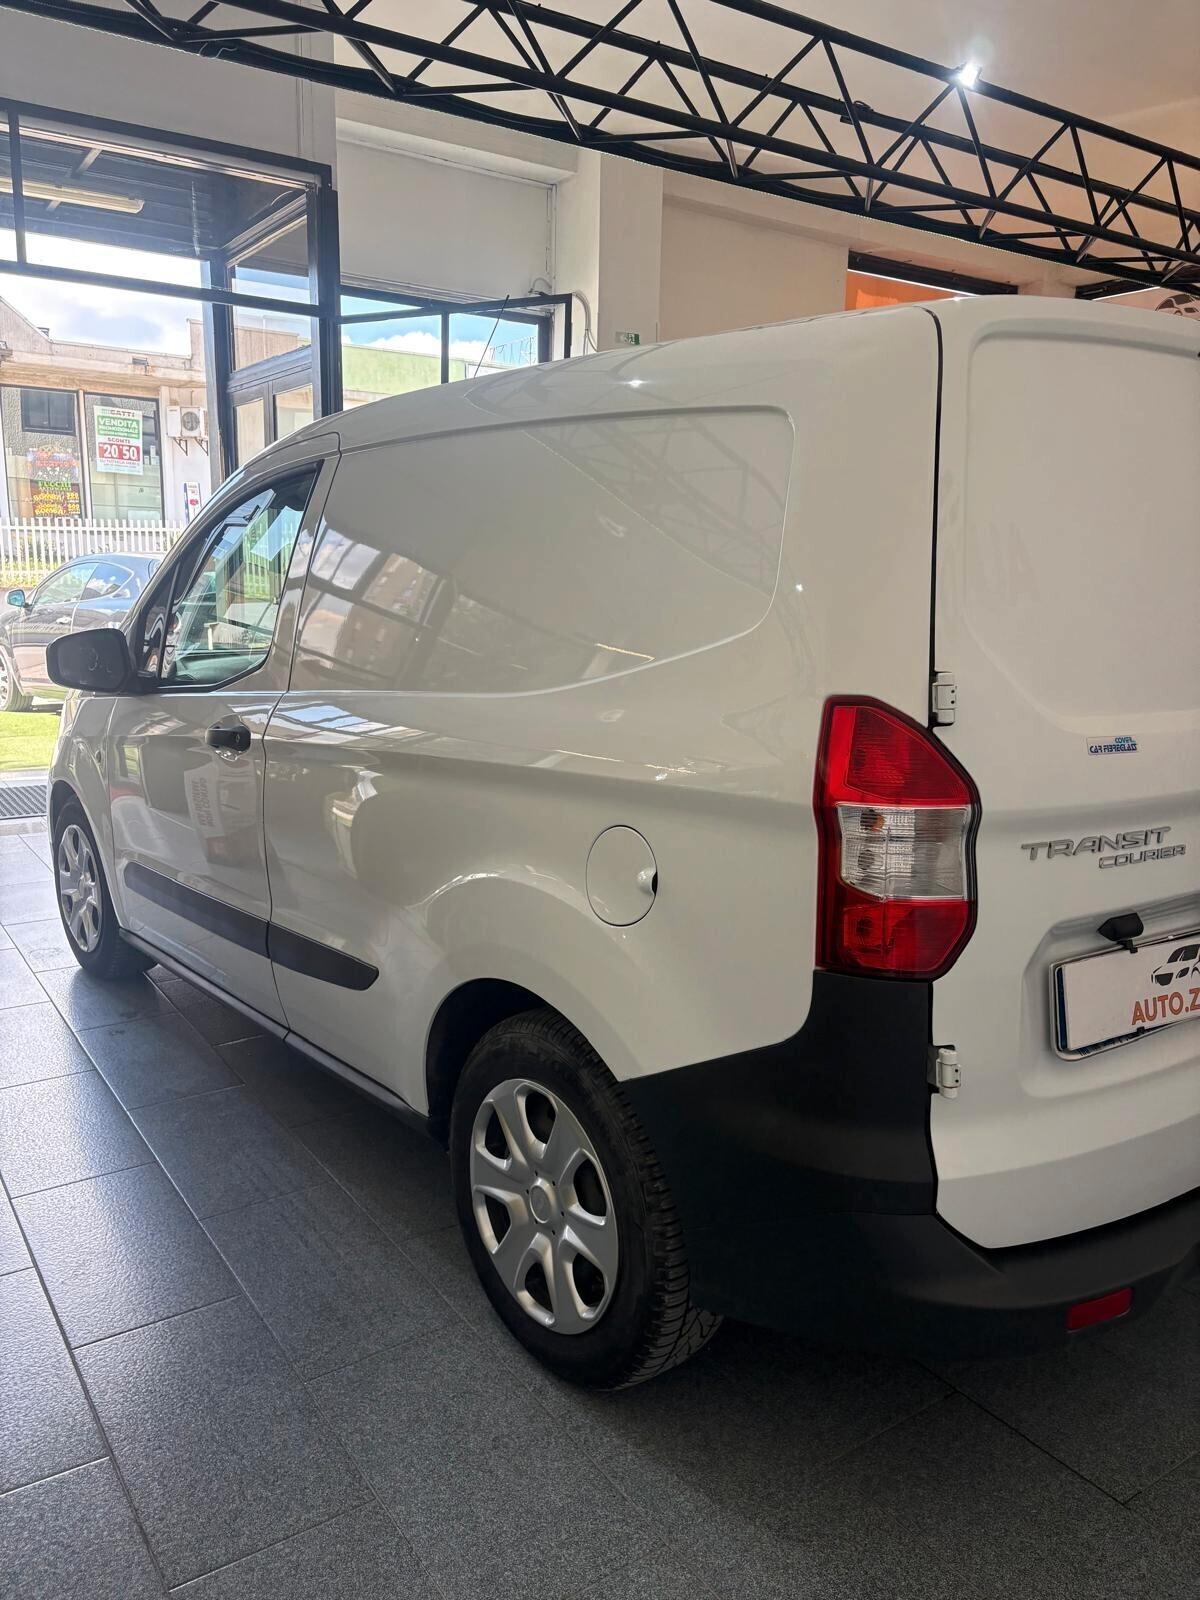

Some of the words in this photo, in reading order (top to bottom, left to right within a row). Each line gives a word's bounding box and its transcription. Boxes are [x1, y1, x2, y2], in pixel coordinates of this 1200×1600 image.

[98, 417, 138, 429] VENDITA
[103, 444, 118, 458] 20
[1089, 745, 1103, 754] CAR
[1021, 826, 1171, 861] TRANSIT
[1099, 844, 1186, 869] COURIER
[1132, 987, 1200, 1025] AUTO.Z
